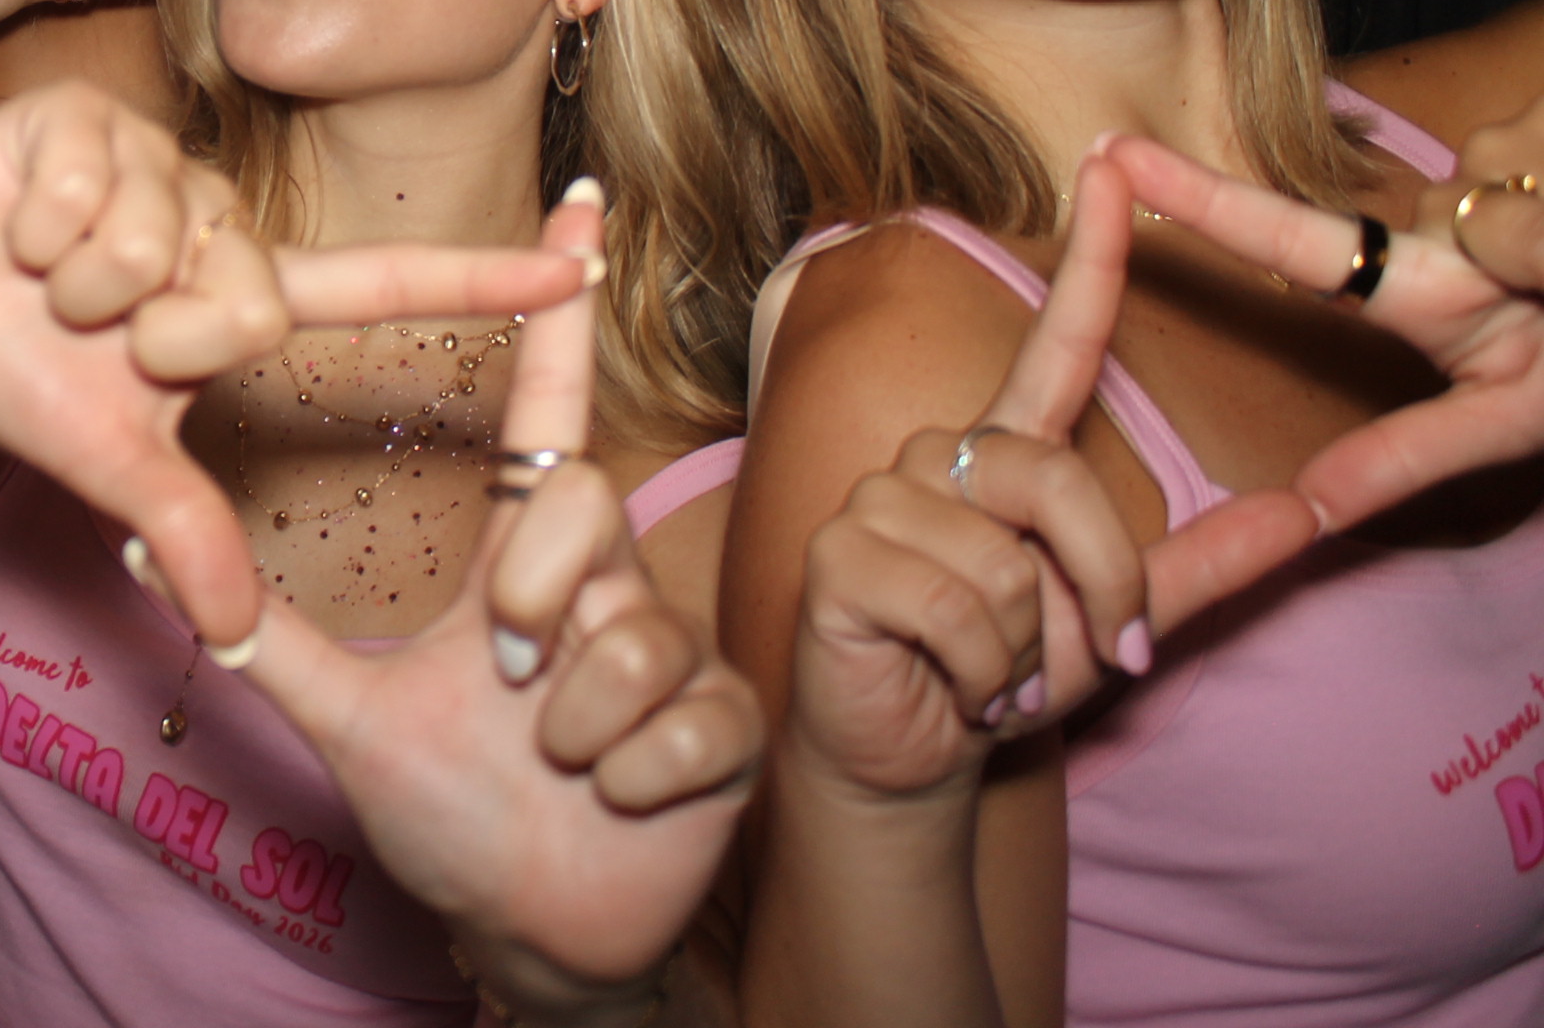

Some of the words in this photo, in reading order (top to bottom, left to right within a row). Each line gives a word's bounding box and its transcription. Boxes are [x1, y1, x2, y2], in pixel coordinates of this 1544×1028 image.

[64, 655, 94, 692] to
[1429, 703, 1541, 797] welcome
[133, 772, 229, 875] DEL
[240, 827, 355, 928] SOL
[274, 915, 334, 955] 2026
